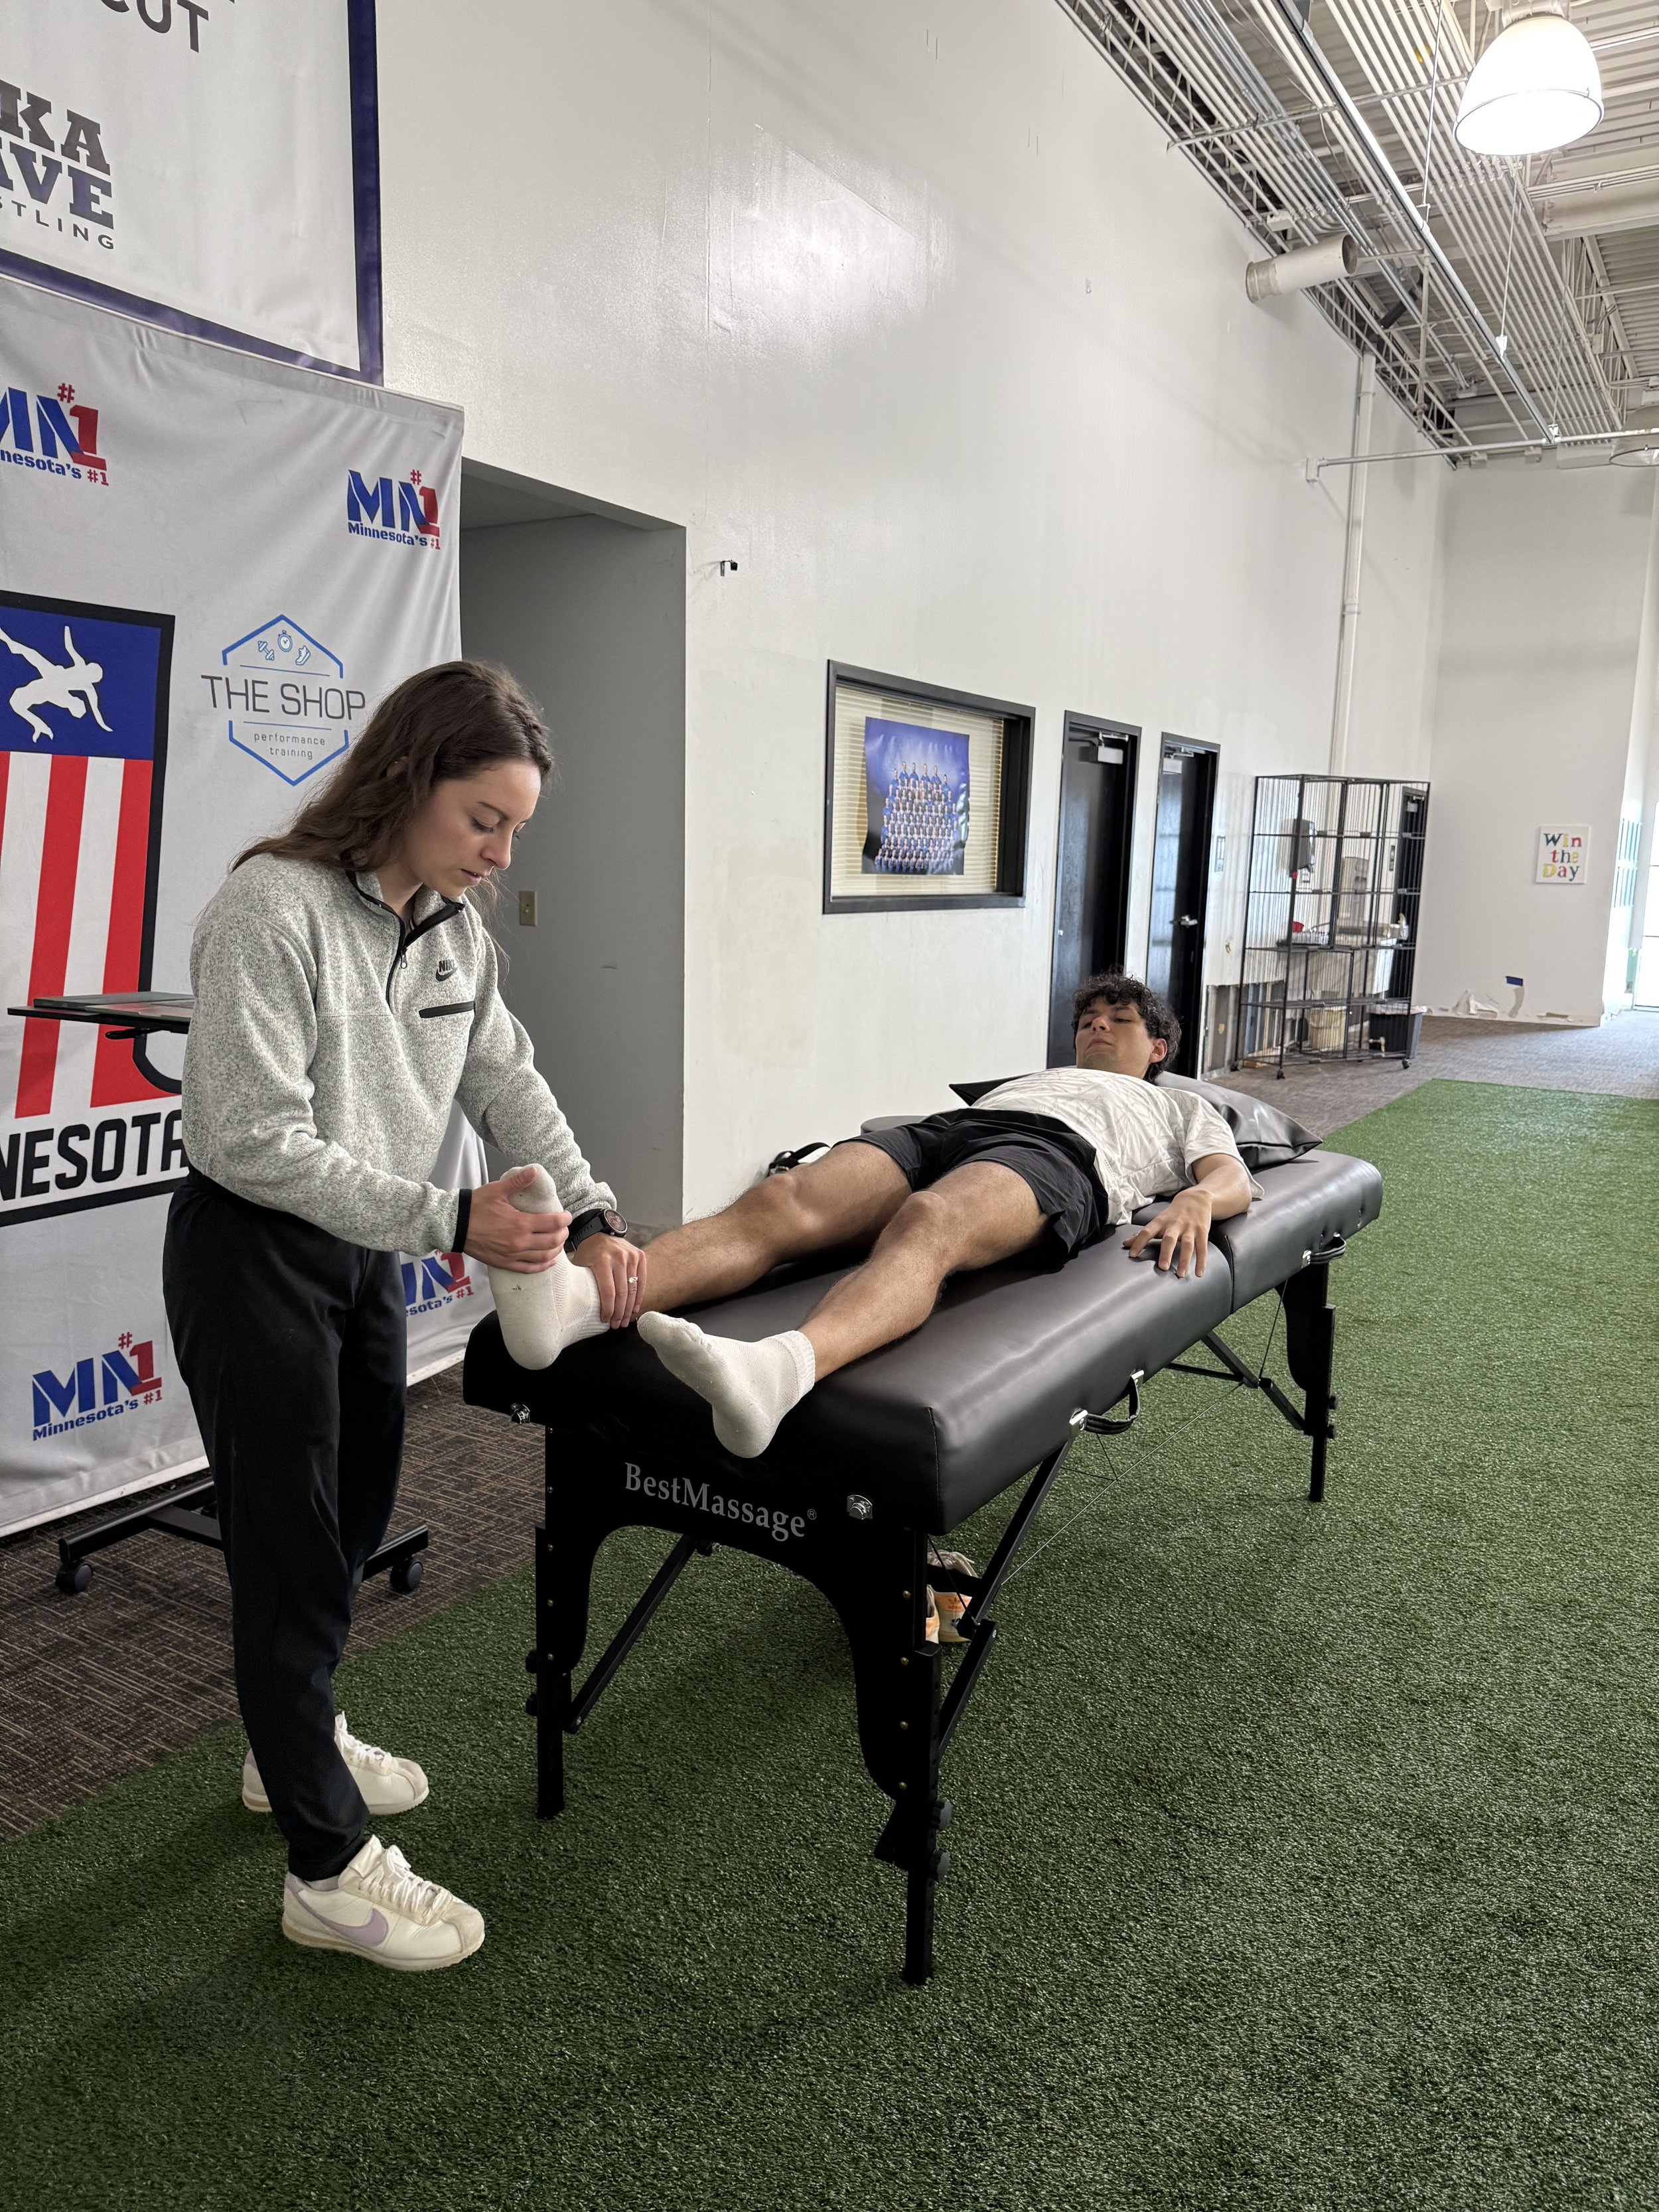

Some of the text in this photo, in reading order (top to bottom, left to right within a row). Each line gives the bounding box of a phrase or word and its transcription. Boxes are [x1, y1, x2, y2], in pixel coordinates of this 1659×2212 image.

[0, 137, 114, 230] VE
[0, 196, 114, 250] TLING
[87, 469, 109, 486] #1
[348, 522, 427, 546] Minnesota's
[201, 675, 366, 720] THE SHOP
[254, 733, 325, 745] performance
[269, 747, 313, 760] training
[1544, 832, 1582, 848] Win
[1550, 849, 1579, 863] the
[1543, 863, 1580, 881] Day
[456, 1286, 474, 1299] #1
[33, 1390, 163, 1441] Minnesota's #1
